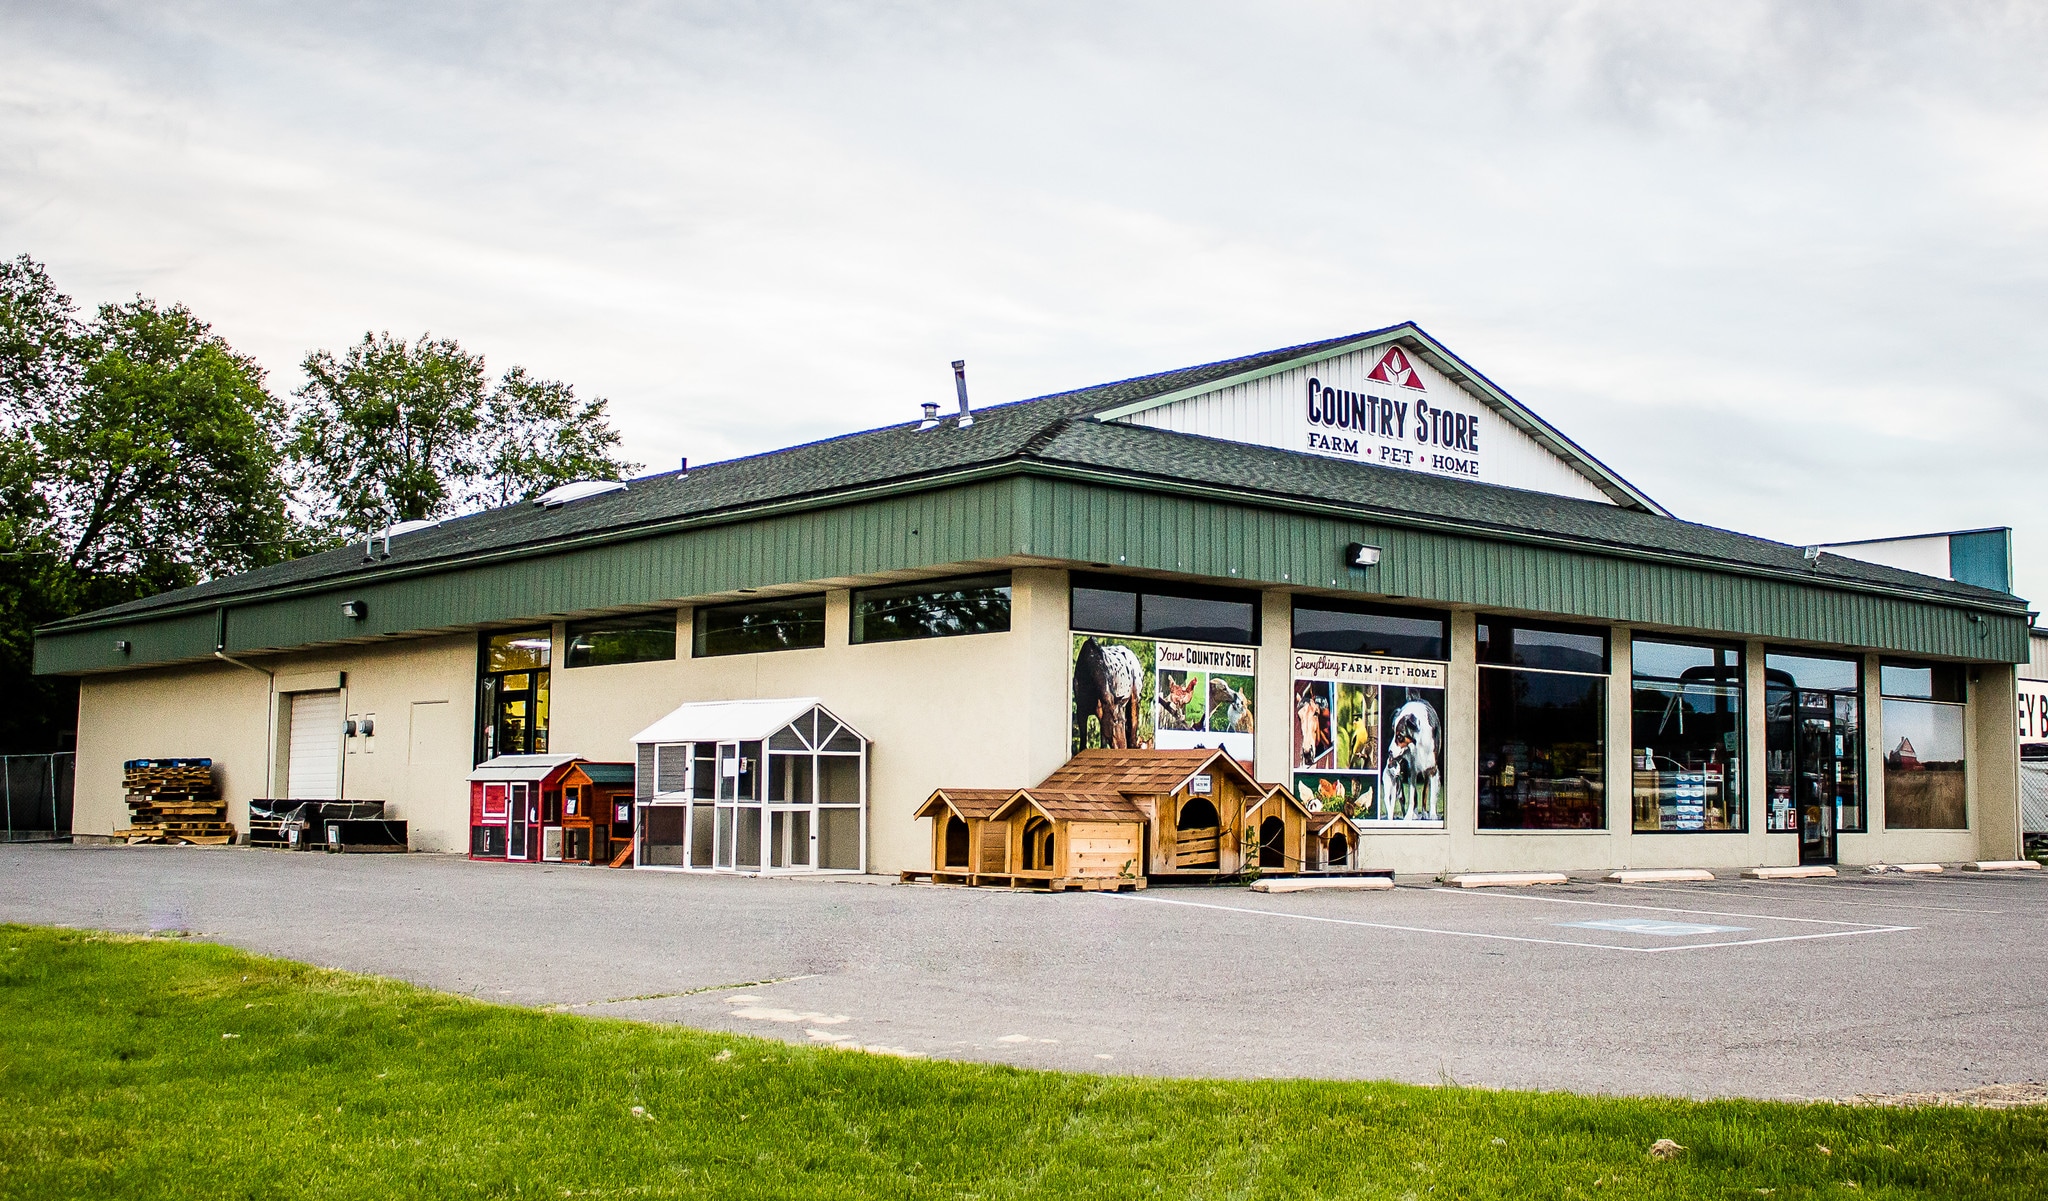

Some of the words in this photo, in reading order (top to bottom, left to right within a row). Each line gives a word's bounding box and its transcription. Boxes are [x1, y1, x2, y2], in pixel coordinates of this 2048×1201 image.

[1308, 377, 1408, 438] COUNTRY
[1415, 399, 1478, 451] STORE
[1308, 432, 1359, 454] FARM
[1380, 445, 1413, 464] PET
[1433, 454, 1479, 475] HOME
[1159, 646, 1185, 662] Your
[1186, 648, 1224, 666] COUNTRY
[1225, 651, 1251, 668] STORE
[1294, 656, 1340, 676] Everything
[1341, 662, 1373, 674] FARM
[1380, 665, 1400, 676] PET
[1406, 667, 1437, 679] HOME
